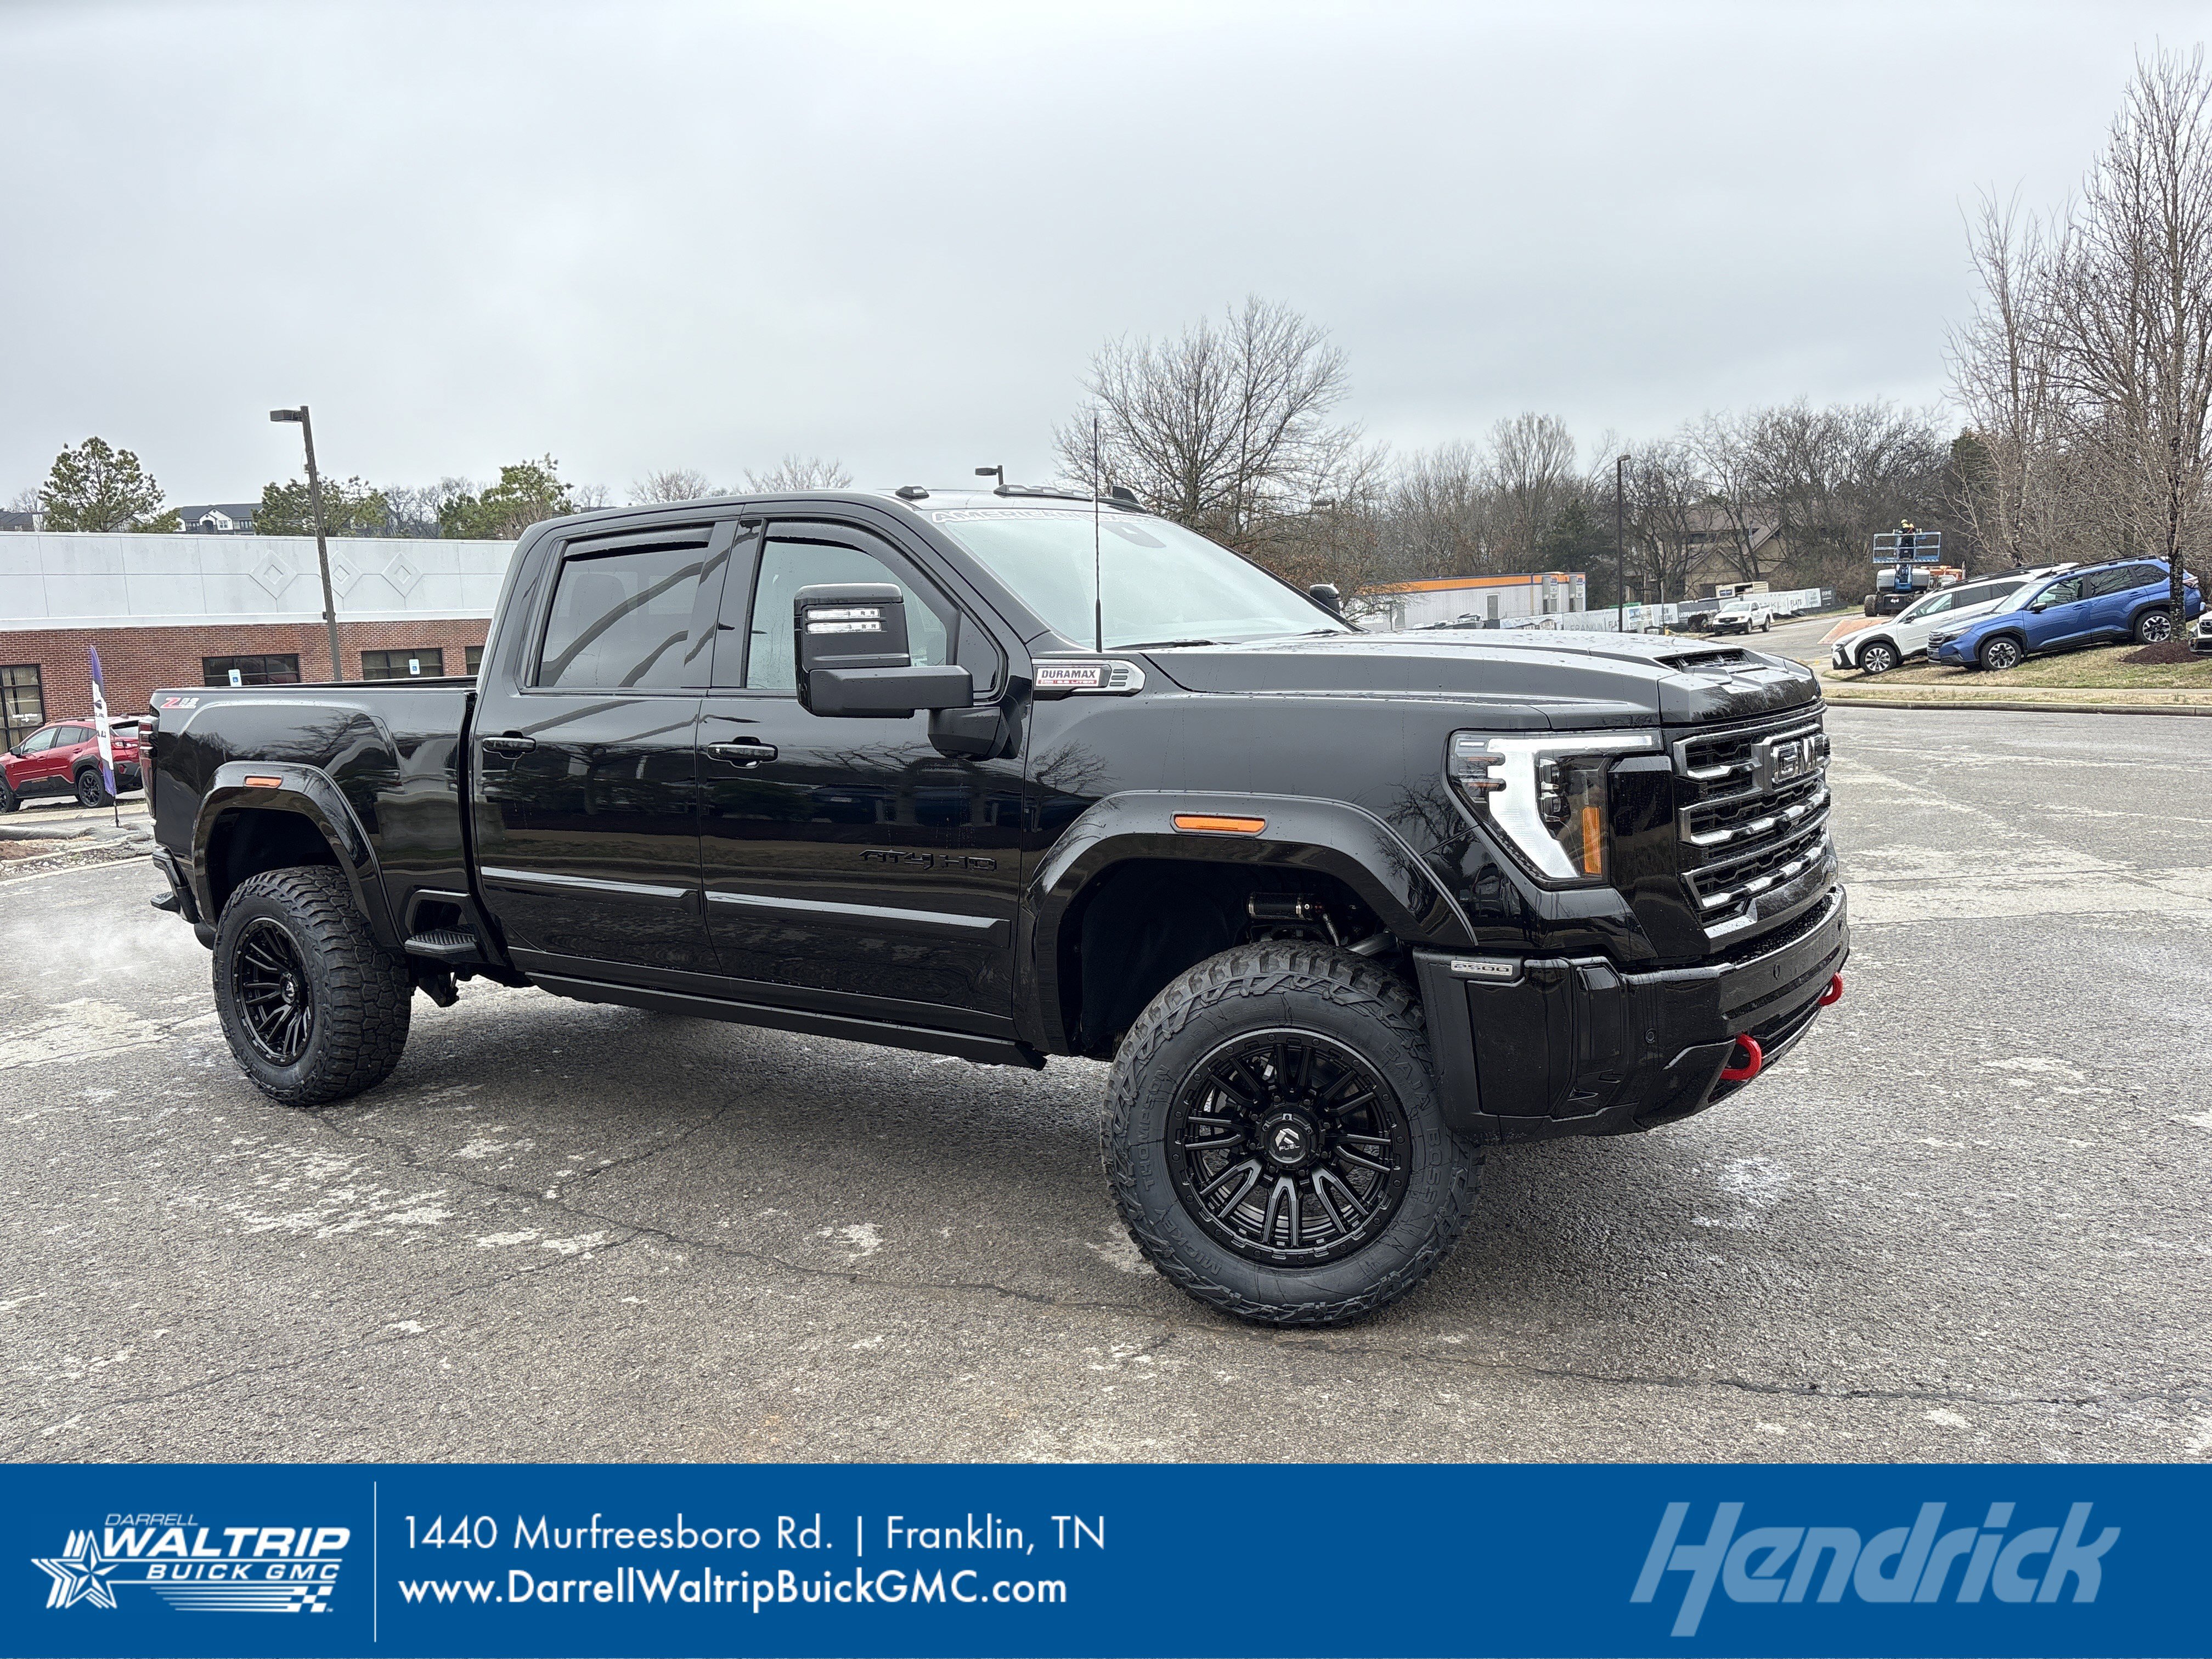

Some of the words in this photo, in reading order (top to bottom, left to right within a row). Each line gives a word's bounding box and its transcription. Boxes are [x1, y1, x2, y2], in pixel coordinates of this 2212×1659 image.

[1042, 670, 1096, 678] DURAMAX
[1771, 734, 1831, 784] GMC
[1454, 964, 1509, 972] 2500
[1380, 1041, 1431, 1110] BAJA
[1417, 1126, 1444, 1206] BOSS
[1279, 1143, 1300, 1152] FUEL
[1153, 1205, 1222, 1275] MICKEY
